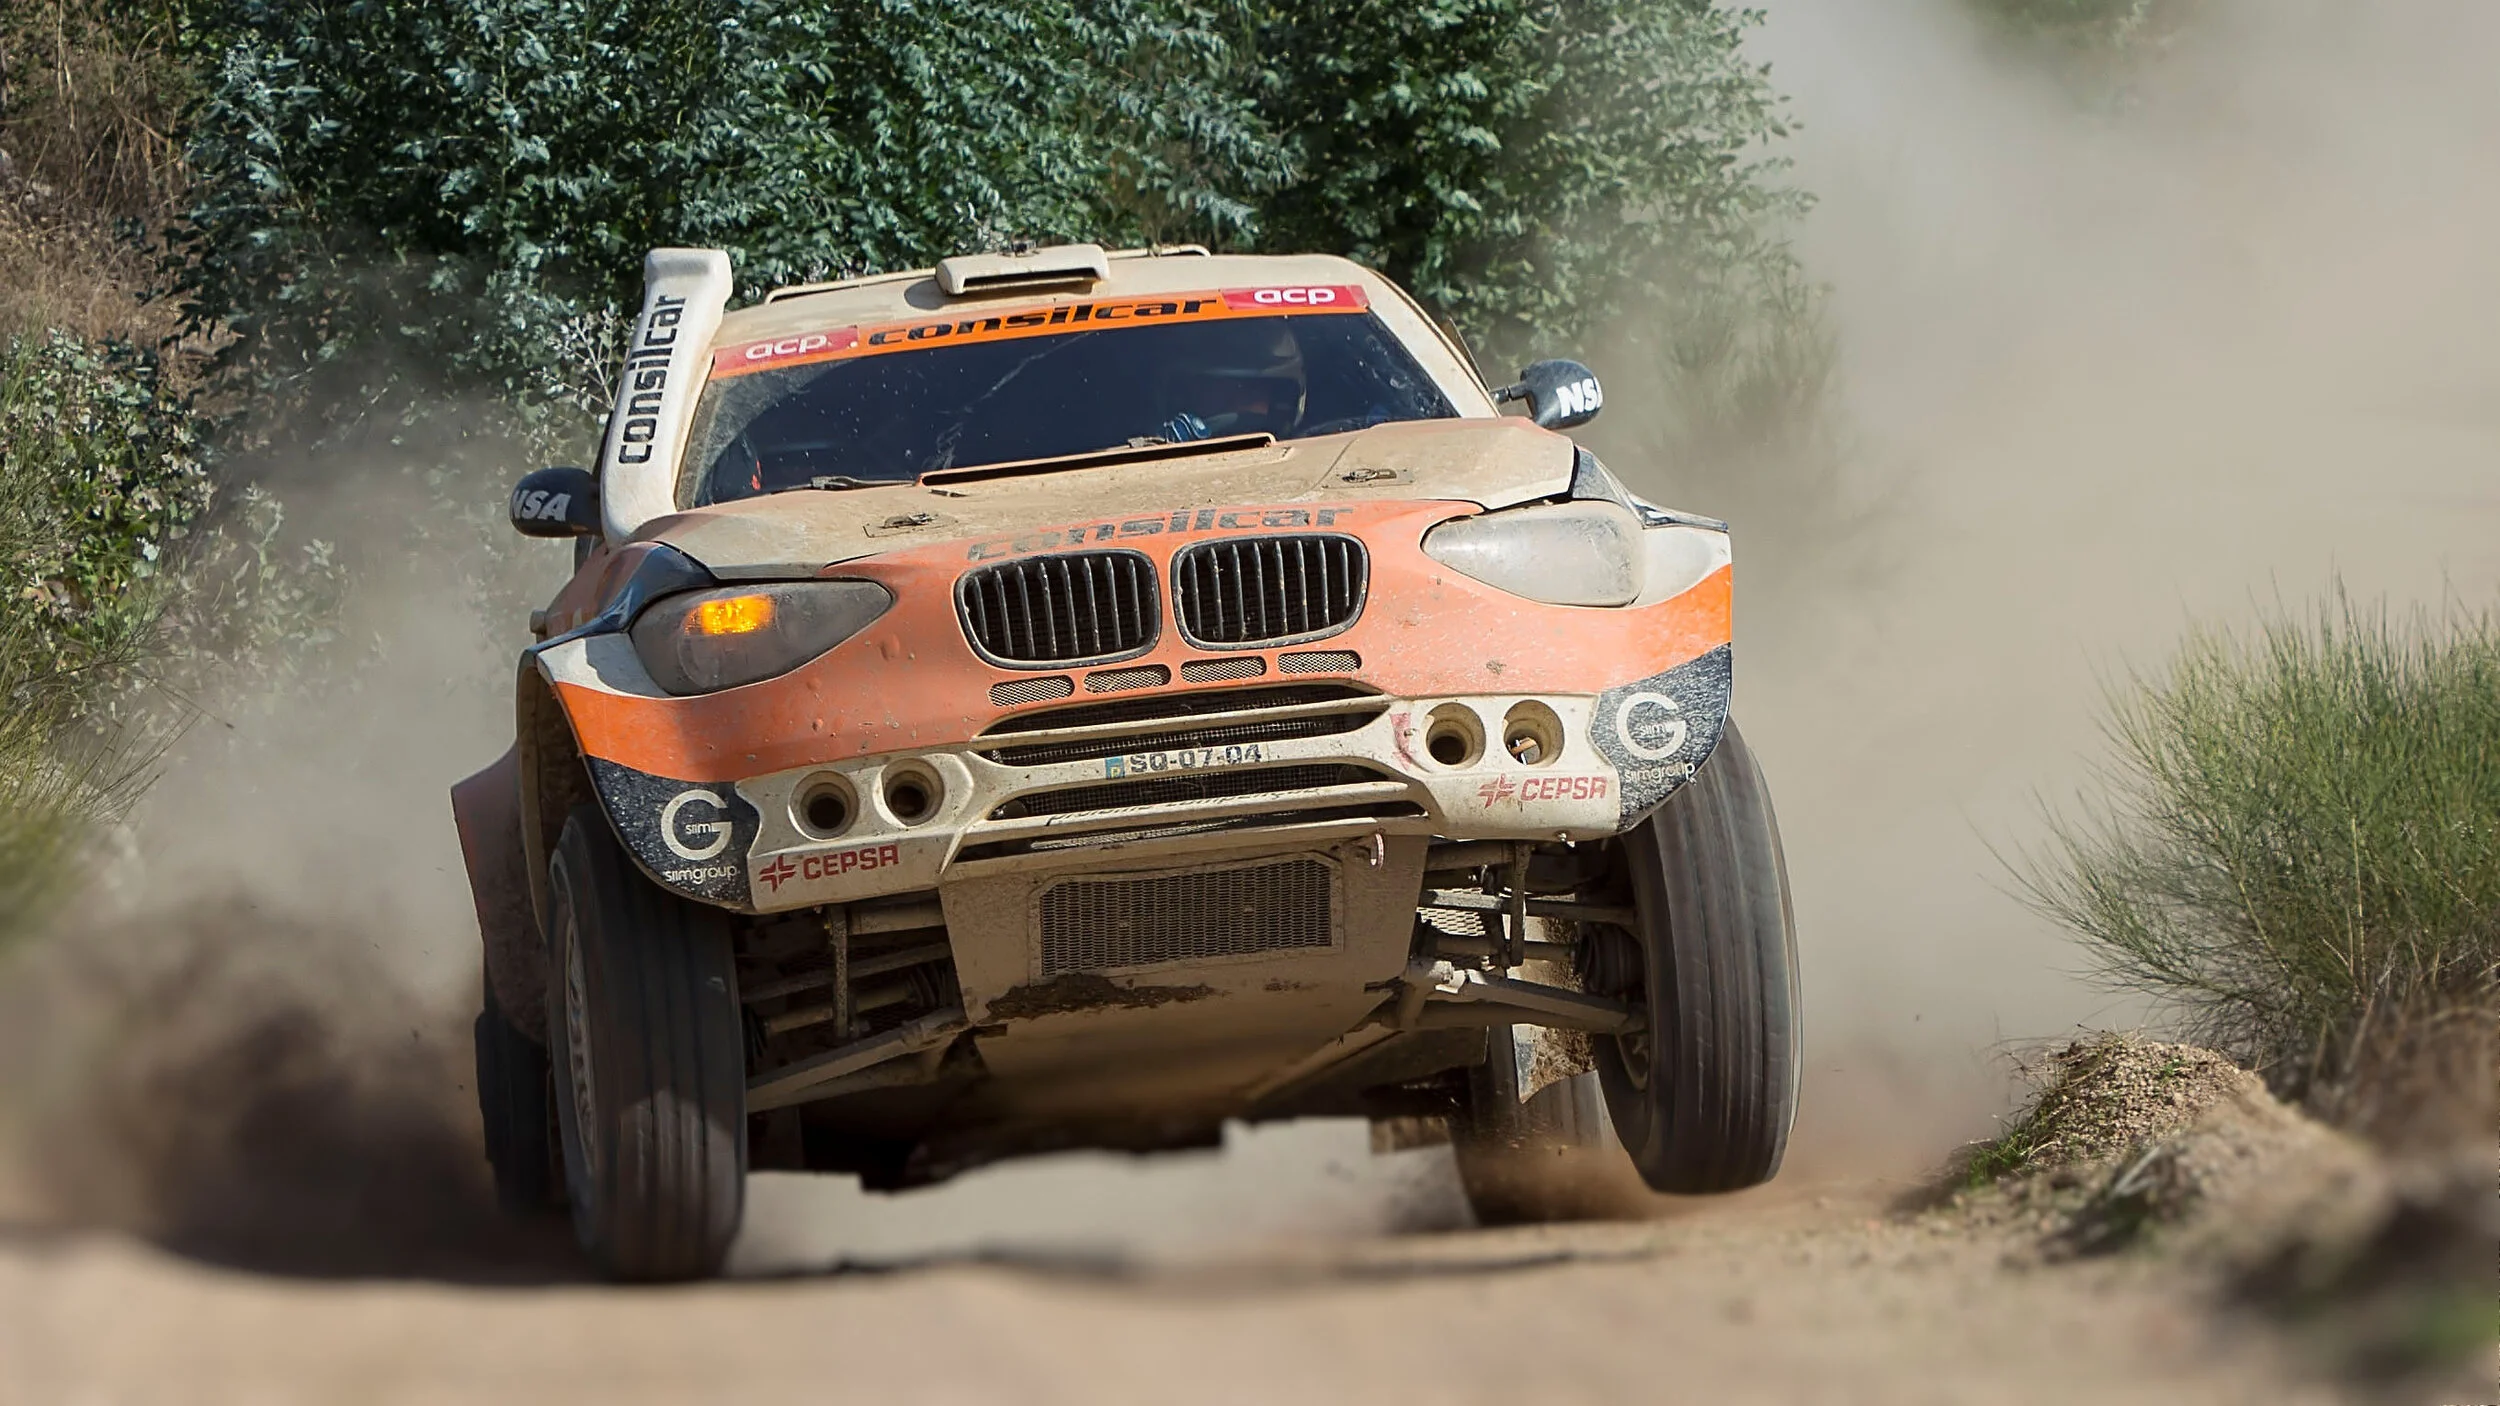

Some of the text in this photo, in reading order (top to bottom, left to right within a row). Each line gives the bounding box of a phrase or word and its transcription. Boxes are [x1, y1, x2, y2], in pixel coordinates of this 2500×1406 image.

[1253, 288, 1335, 306] acp
[868, 297, 1217, 345] consilcar
[745, 335, 827, 361] acp
[618, 294, 686, 464] consilcar
[966, 506, 1354, 562] consilcar
[1520, 777, 1608, 801] CEPSA
[803, 845, 899, 880] CEPSA
